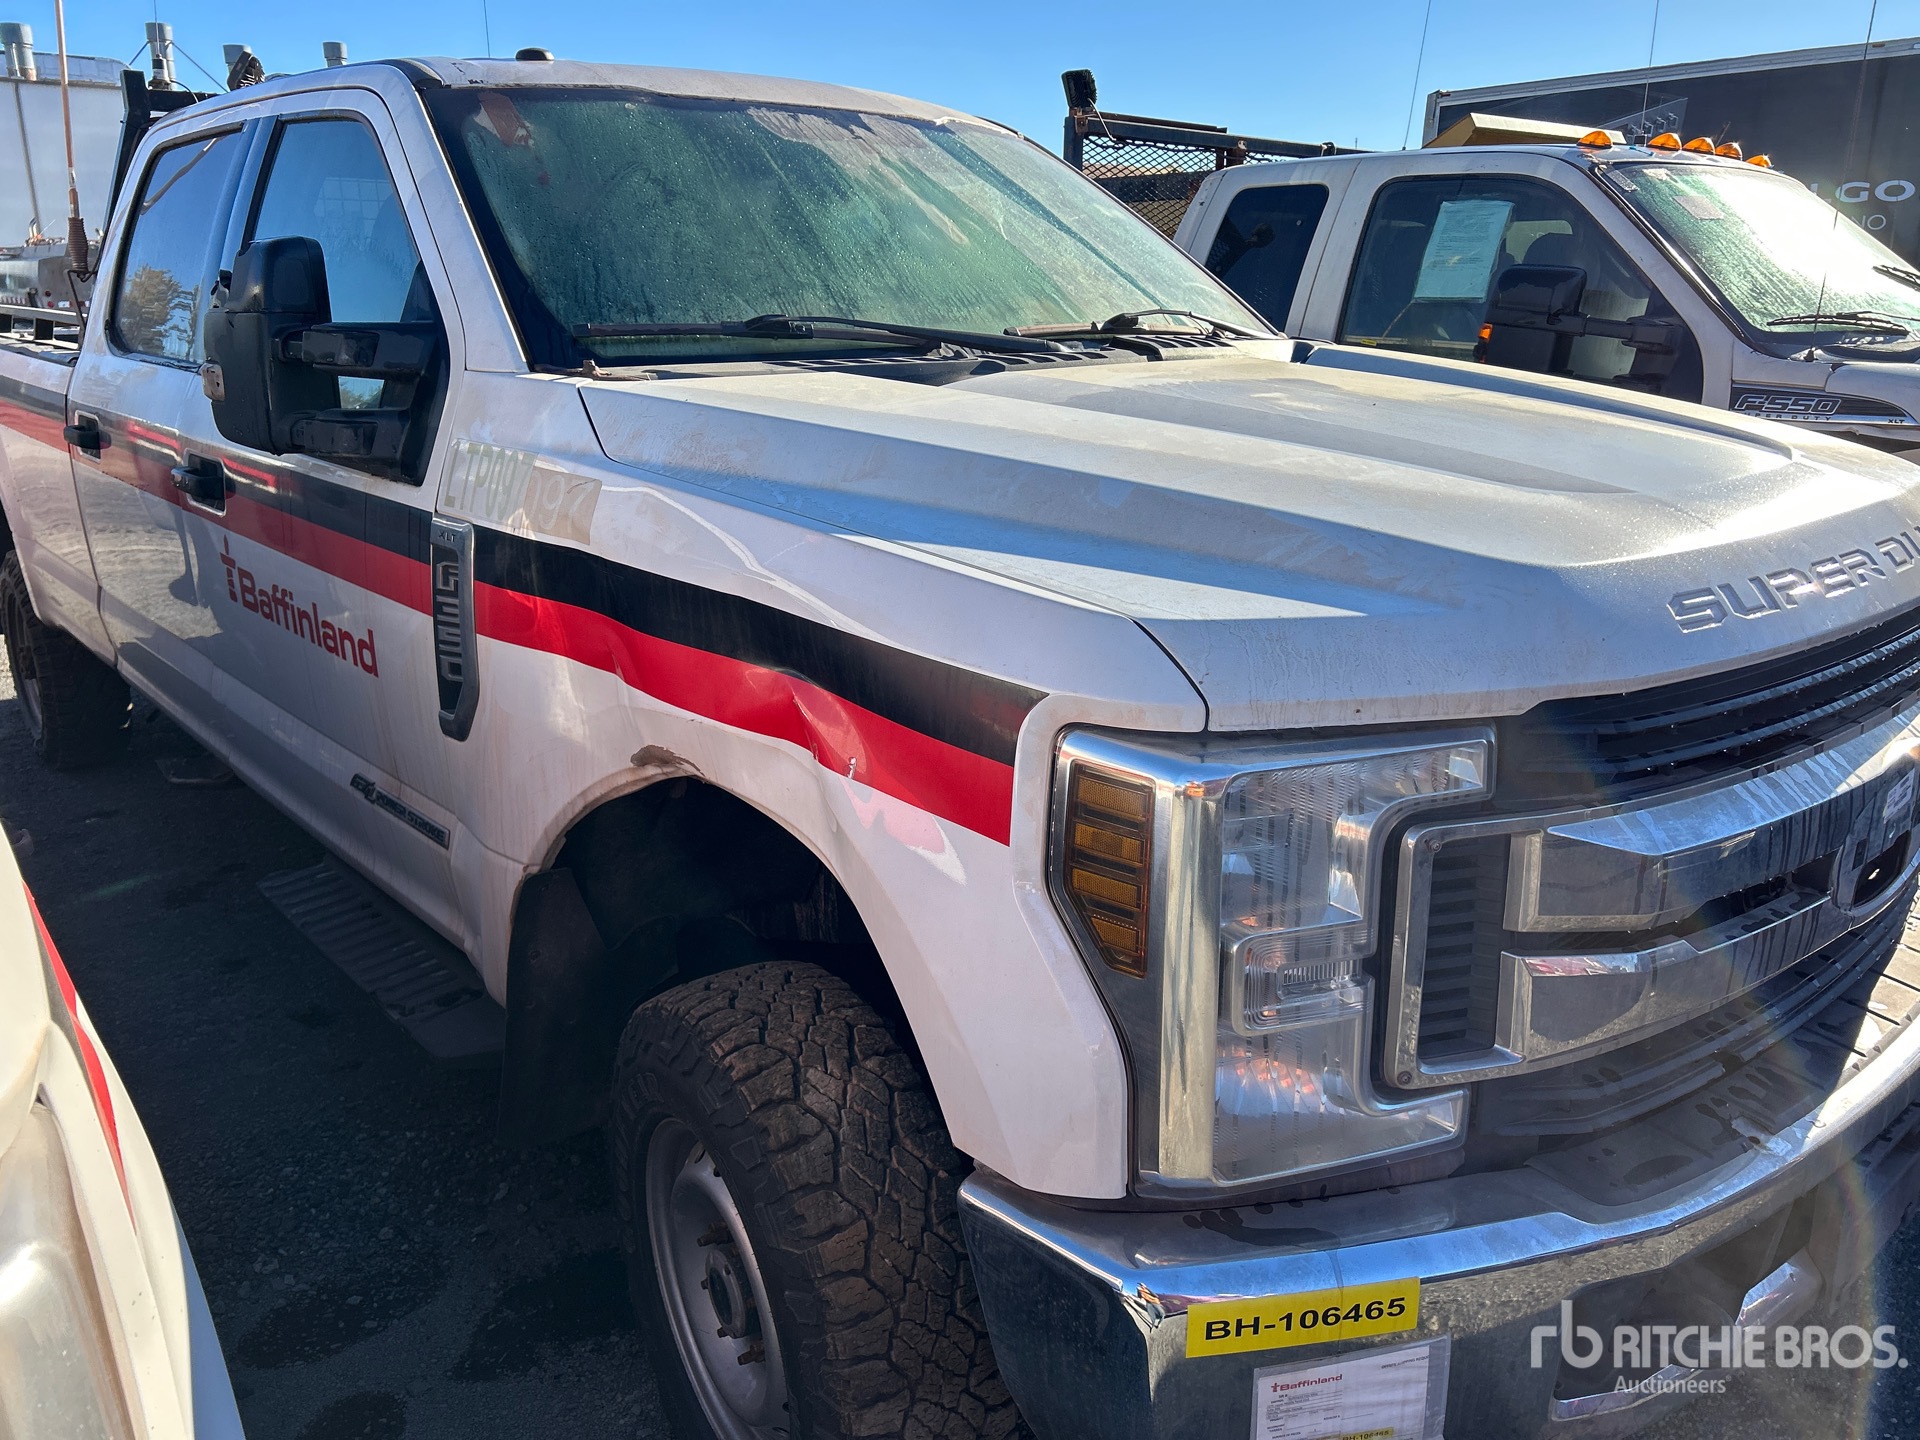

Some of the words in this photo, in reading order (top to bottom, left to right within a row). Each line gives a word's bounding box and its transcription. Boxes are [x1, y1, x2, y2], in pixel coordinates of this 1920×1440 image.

[1734, 393, 1841, 415] F-550
[438, 530, 456, 542] XLT
[1666, 548, 1887, 633] SUPER
[239, 564, 379, 677] Baffinland
[1204, 1297, 1406, 1340] BH-106465
[1280, 1374, 1342, 1391] Baffinland
